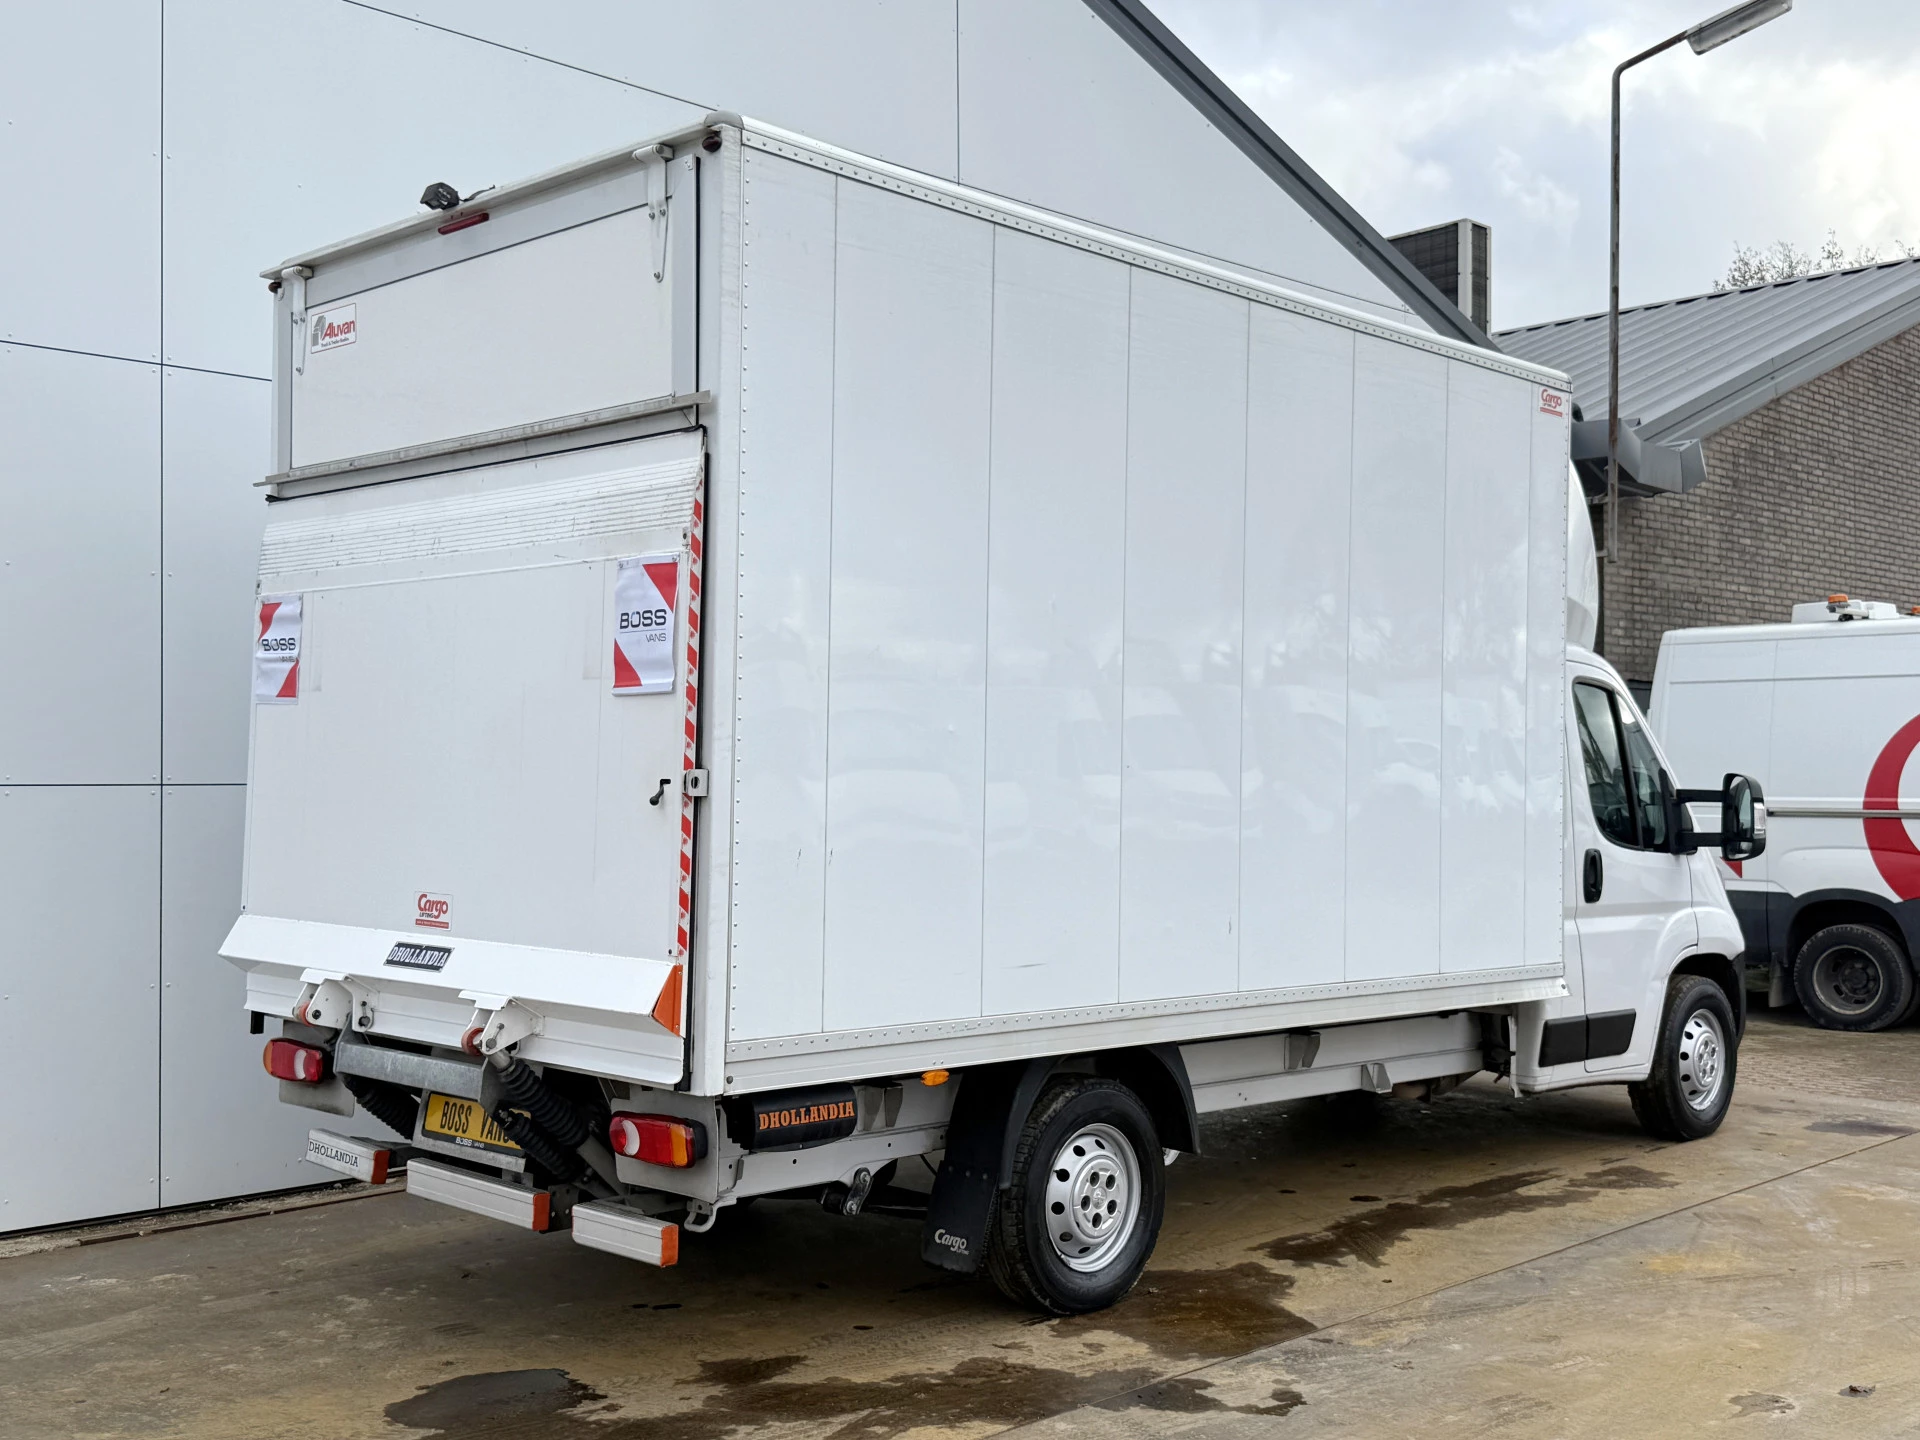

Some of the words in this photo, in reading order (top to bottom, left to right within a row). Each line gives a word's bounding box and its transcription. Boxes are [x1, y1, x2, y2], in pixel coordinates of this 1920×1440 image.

[321, 320, 356, 341] Aluvan
[1541, 388, 1562, 409] Cargo
[620, 608, 667, 630] BOSS
[261, 637, 296, 652] BOSS
[645, 632, 667, 643] VANS
[417, 893, 449, 919] Cargo
[388, 946, 449, 967] DHOLLANDIA
[440, 1101, 472, 1134] BOSS
[758, 1101, 855, 1130] DHOLLANDIA
[455, 1136, 473, 1147] BOSS
[308, 1141, 359, 1168] DHOLLANDIA
[934, 1228, 967, 1252] Cargo
